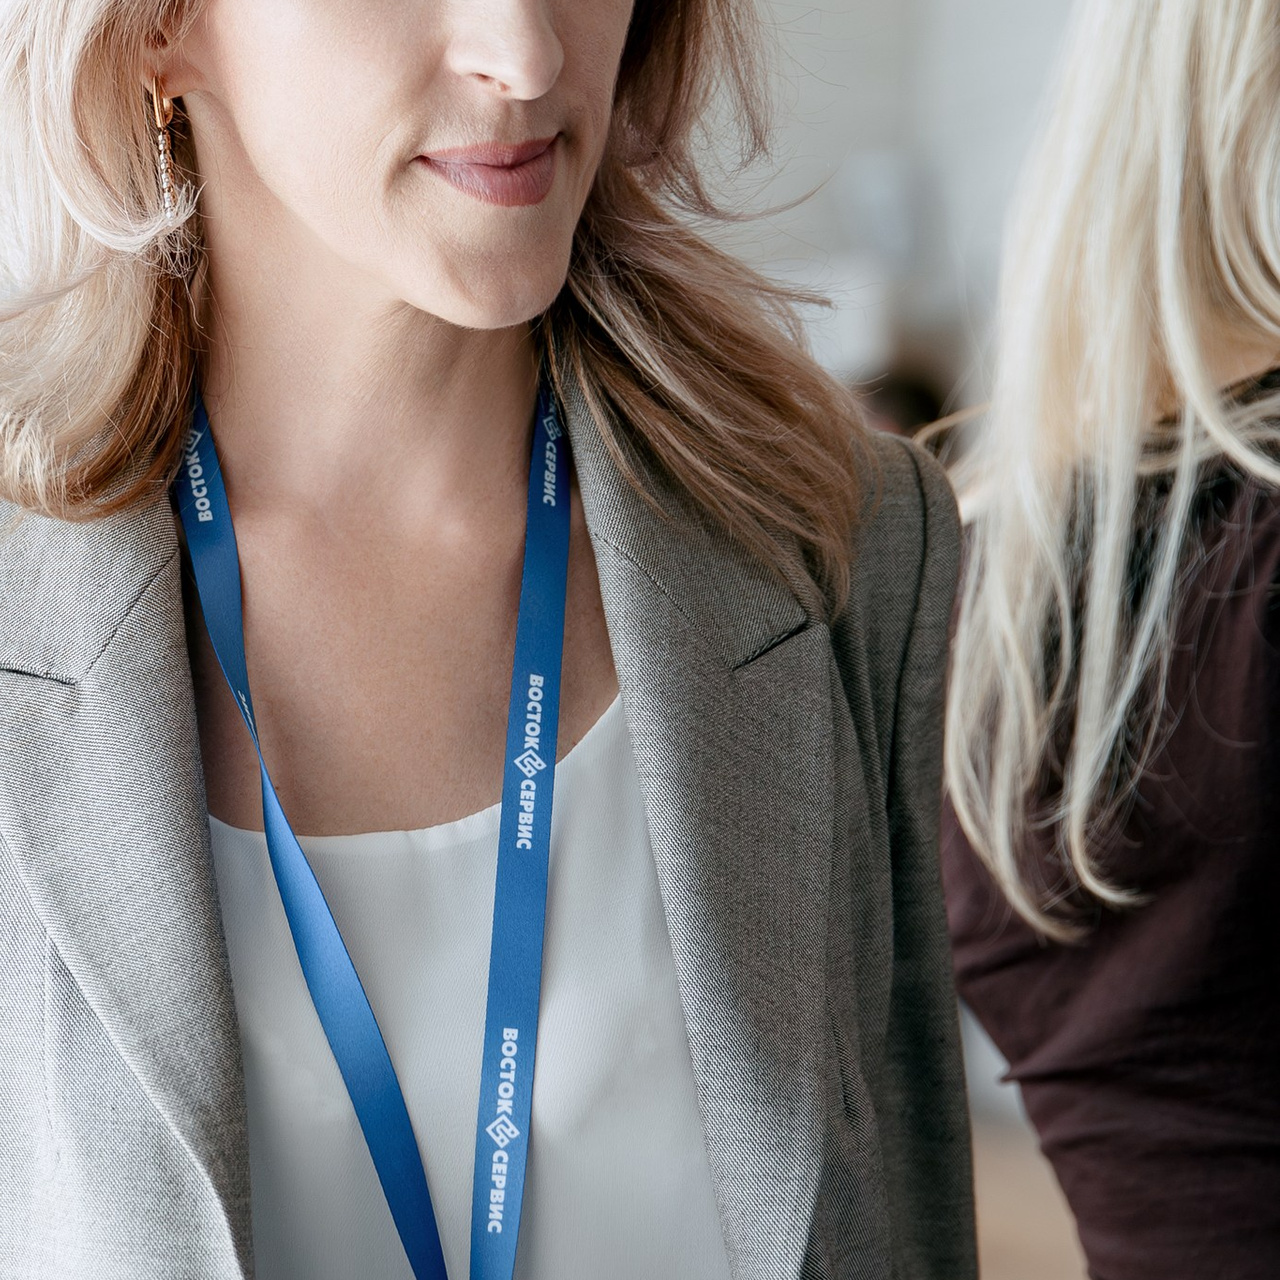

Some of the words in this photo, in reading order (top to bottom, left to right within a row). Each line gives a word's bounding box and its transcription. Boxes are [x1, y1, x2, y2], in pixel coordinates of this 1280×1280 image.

[185, 450, 214, 522] ВОСТОК
[543, 441, 557, 507] СЕРВИС
[524, 673, 545, 751] ВОСТОК
[516, 779, 537, 850] СЕРВИС
[496, 1027, 519, 1115] ВОСТОК
[487, 1149, 509, 1233] СЕРВИС
